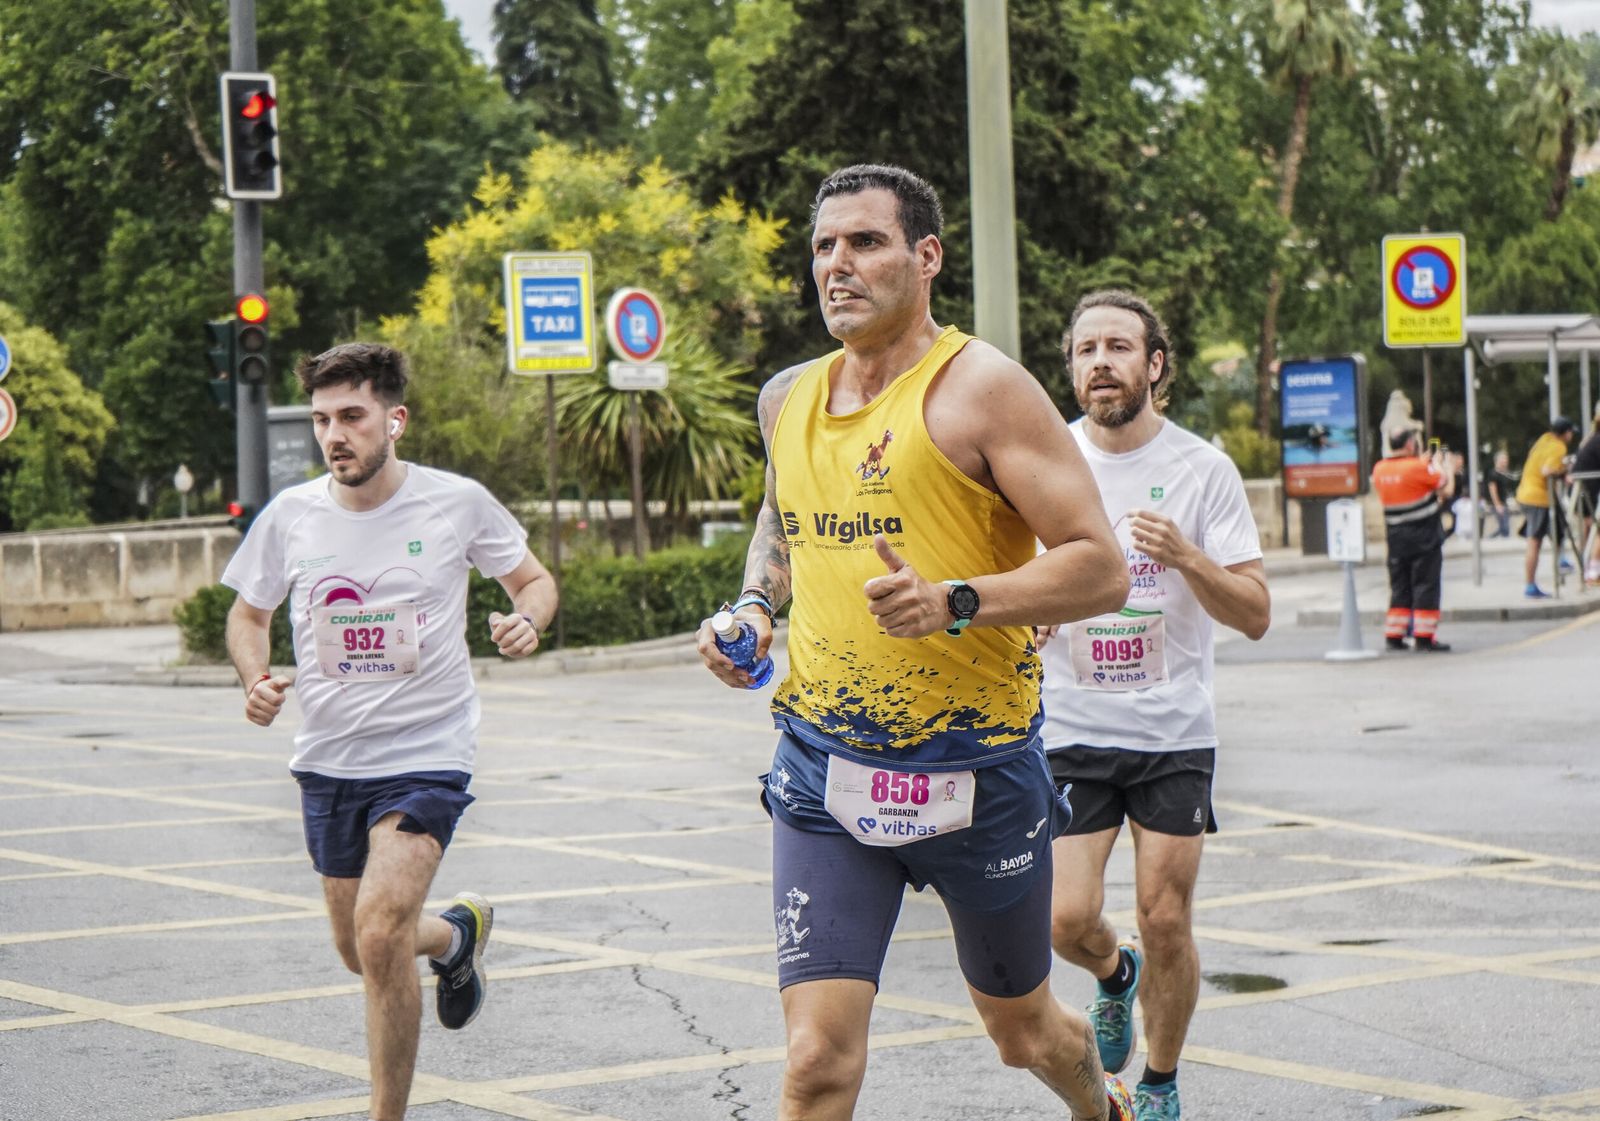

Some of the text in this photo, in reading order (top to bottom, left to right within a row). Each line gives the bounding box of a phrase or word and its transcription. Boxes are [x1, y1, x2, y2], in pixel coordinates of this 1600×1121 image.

[531, 315, 575, 333] TAXI
[1430, 316, 1451, 326] BUS
[813, 511, 903, 544] Vigilsa
[343, 626, 386, 651] 932
[1091, 637, 1144, 662] 8093
[355, 662, 396, 673] vithas
[1109, 671, 1146, 683] vithas
[871, 770, 930, 805] 858
[878, 807, 919, 818] GARBANZIN
[881, 820, 937, 836] vithas
[984, 850, 1034, 873] AL BAYDA
